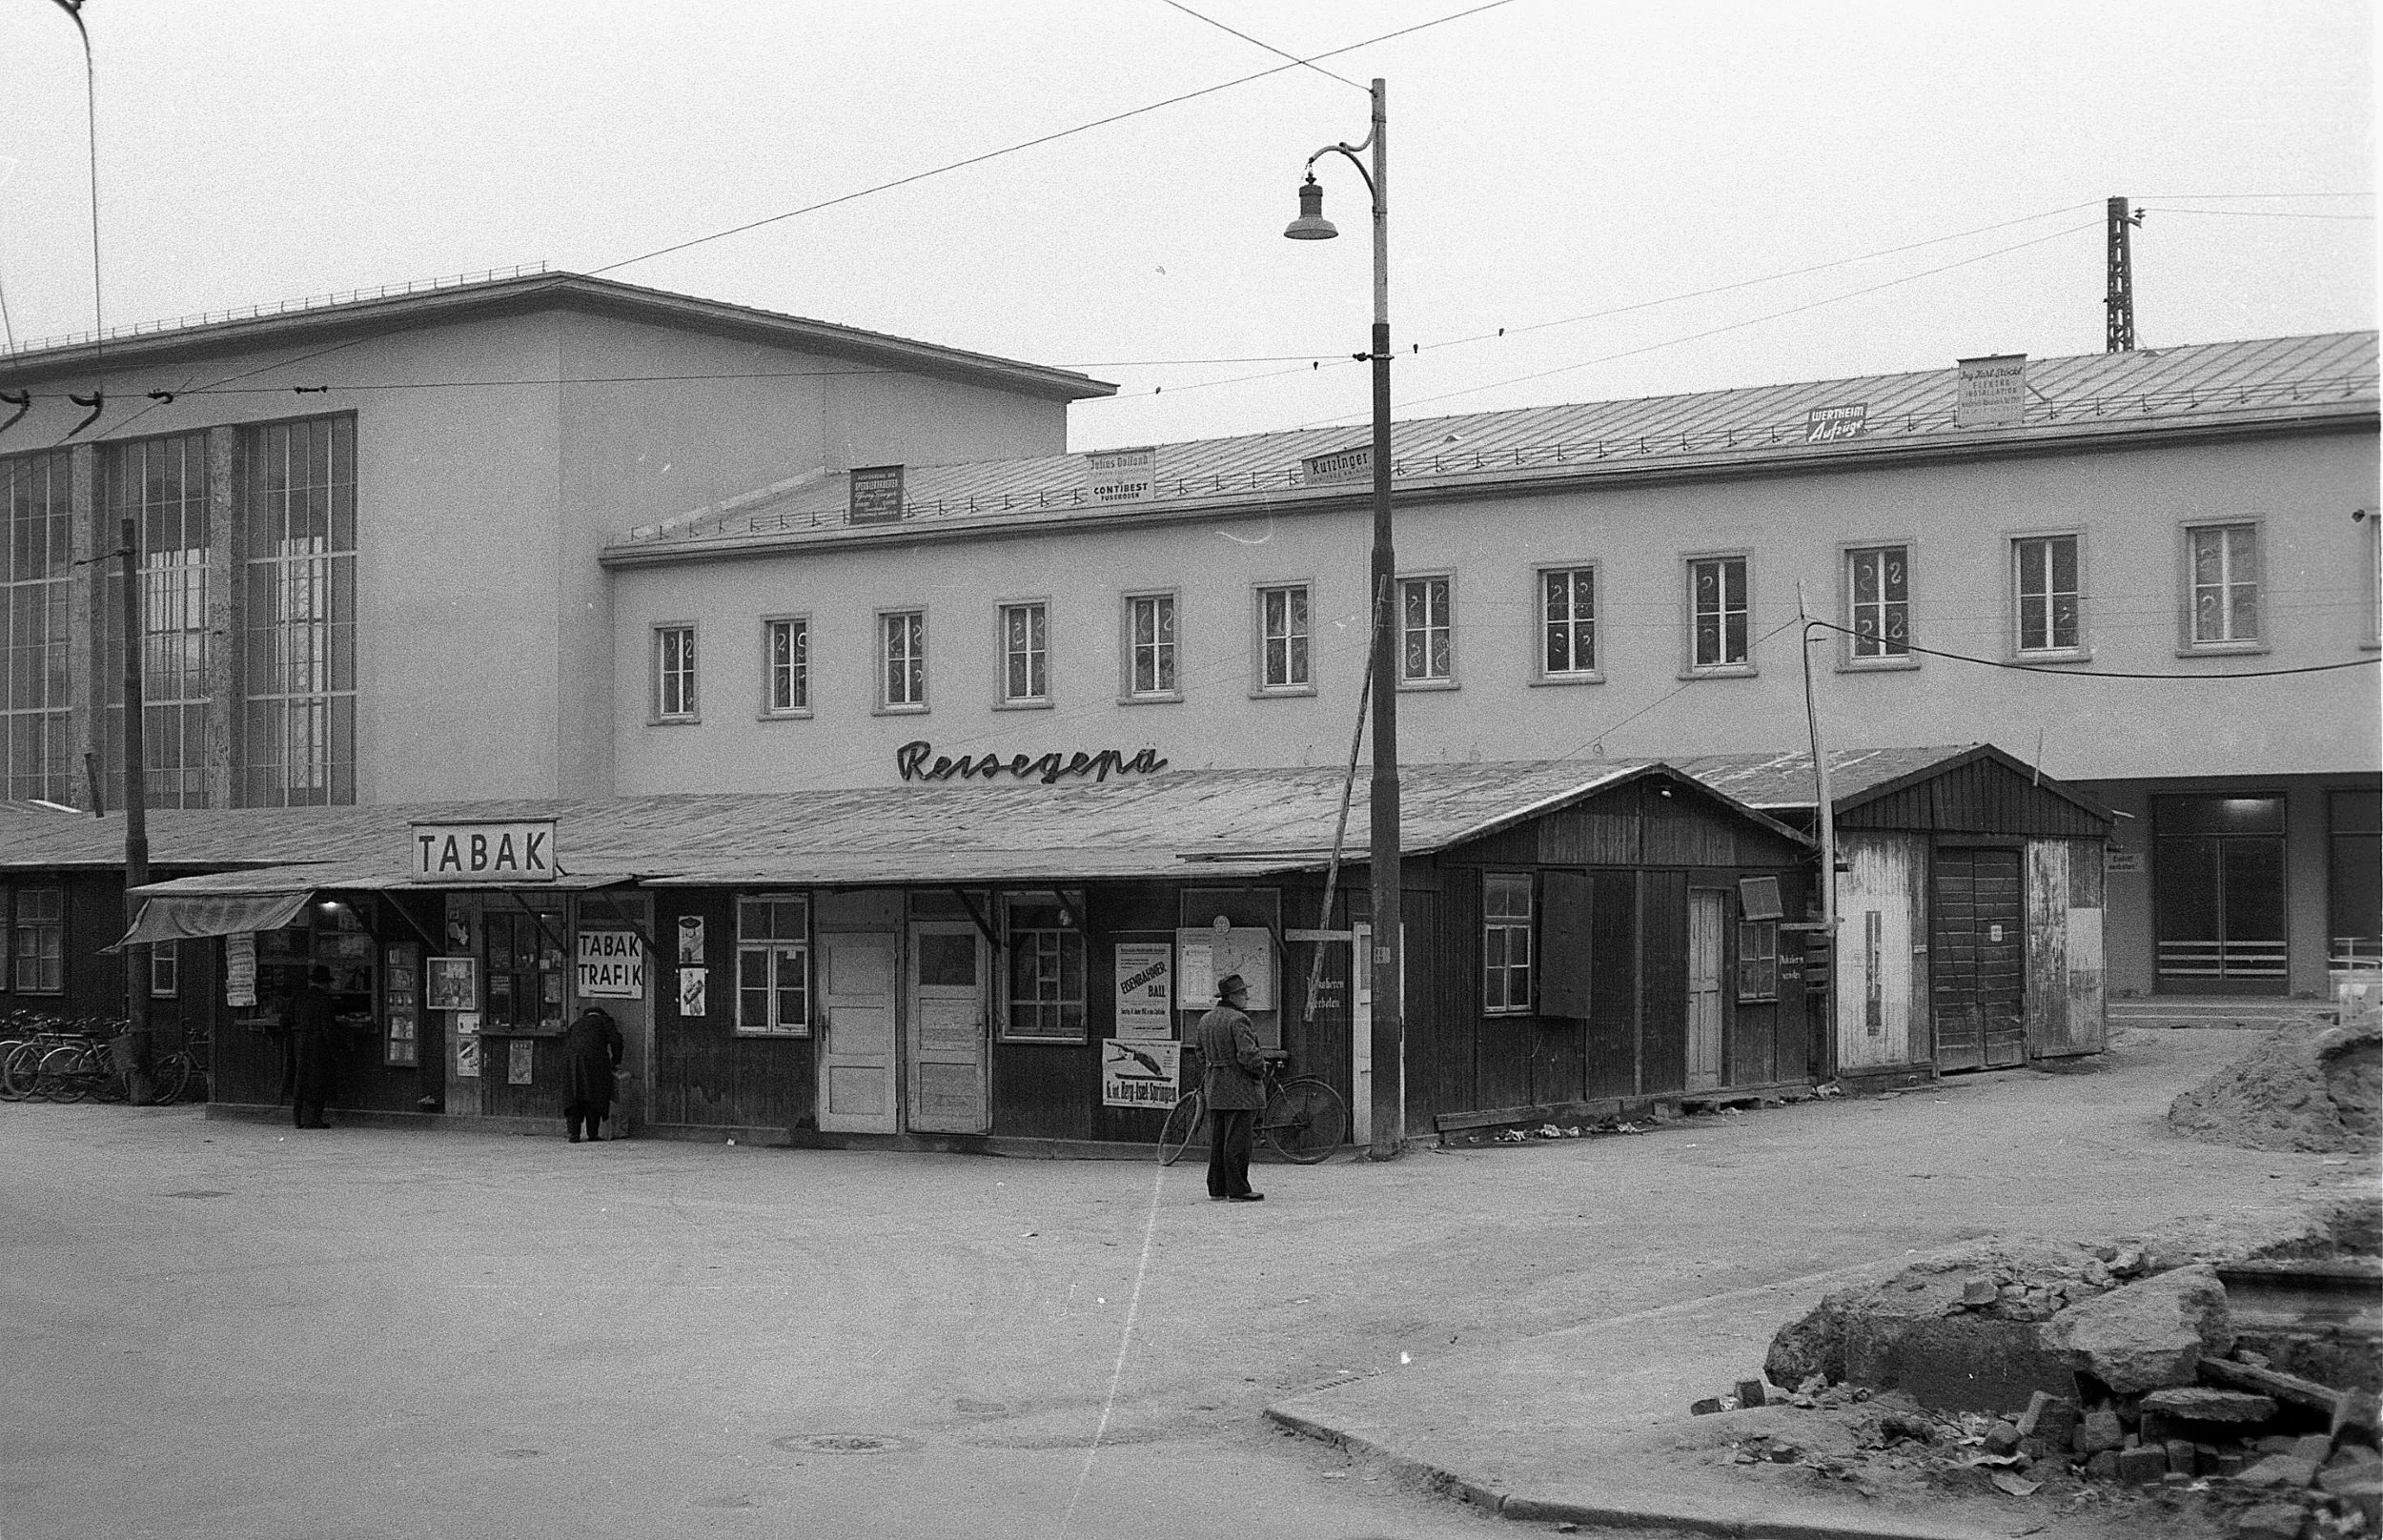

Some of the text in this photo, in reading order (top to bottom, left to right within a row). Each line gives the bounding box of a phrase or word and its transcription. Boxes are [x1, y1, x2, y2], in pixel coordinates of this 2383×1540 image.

[1812, 406, 1864, 421] WERTHEIM
[1808, 419, 1864, 442] Aufzüge
[1312, 453, 1367, 475] Rutzinger
[1093, 482, 1148, 495] CONTIBEST
[418, 831, 546, 873] TABAK
[580, 935, 640, 957] TABAK
[578, 963, 642, 986] TRAFIK
[1120, 961, 1168, 995] EISENBAHNER
[1148, 984, 1166, 998] BALL
